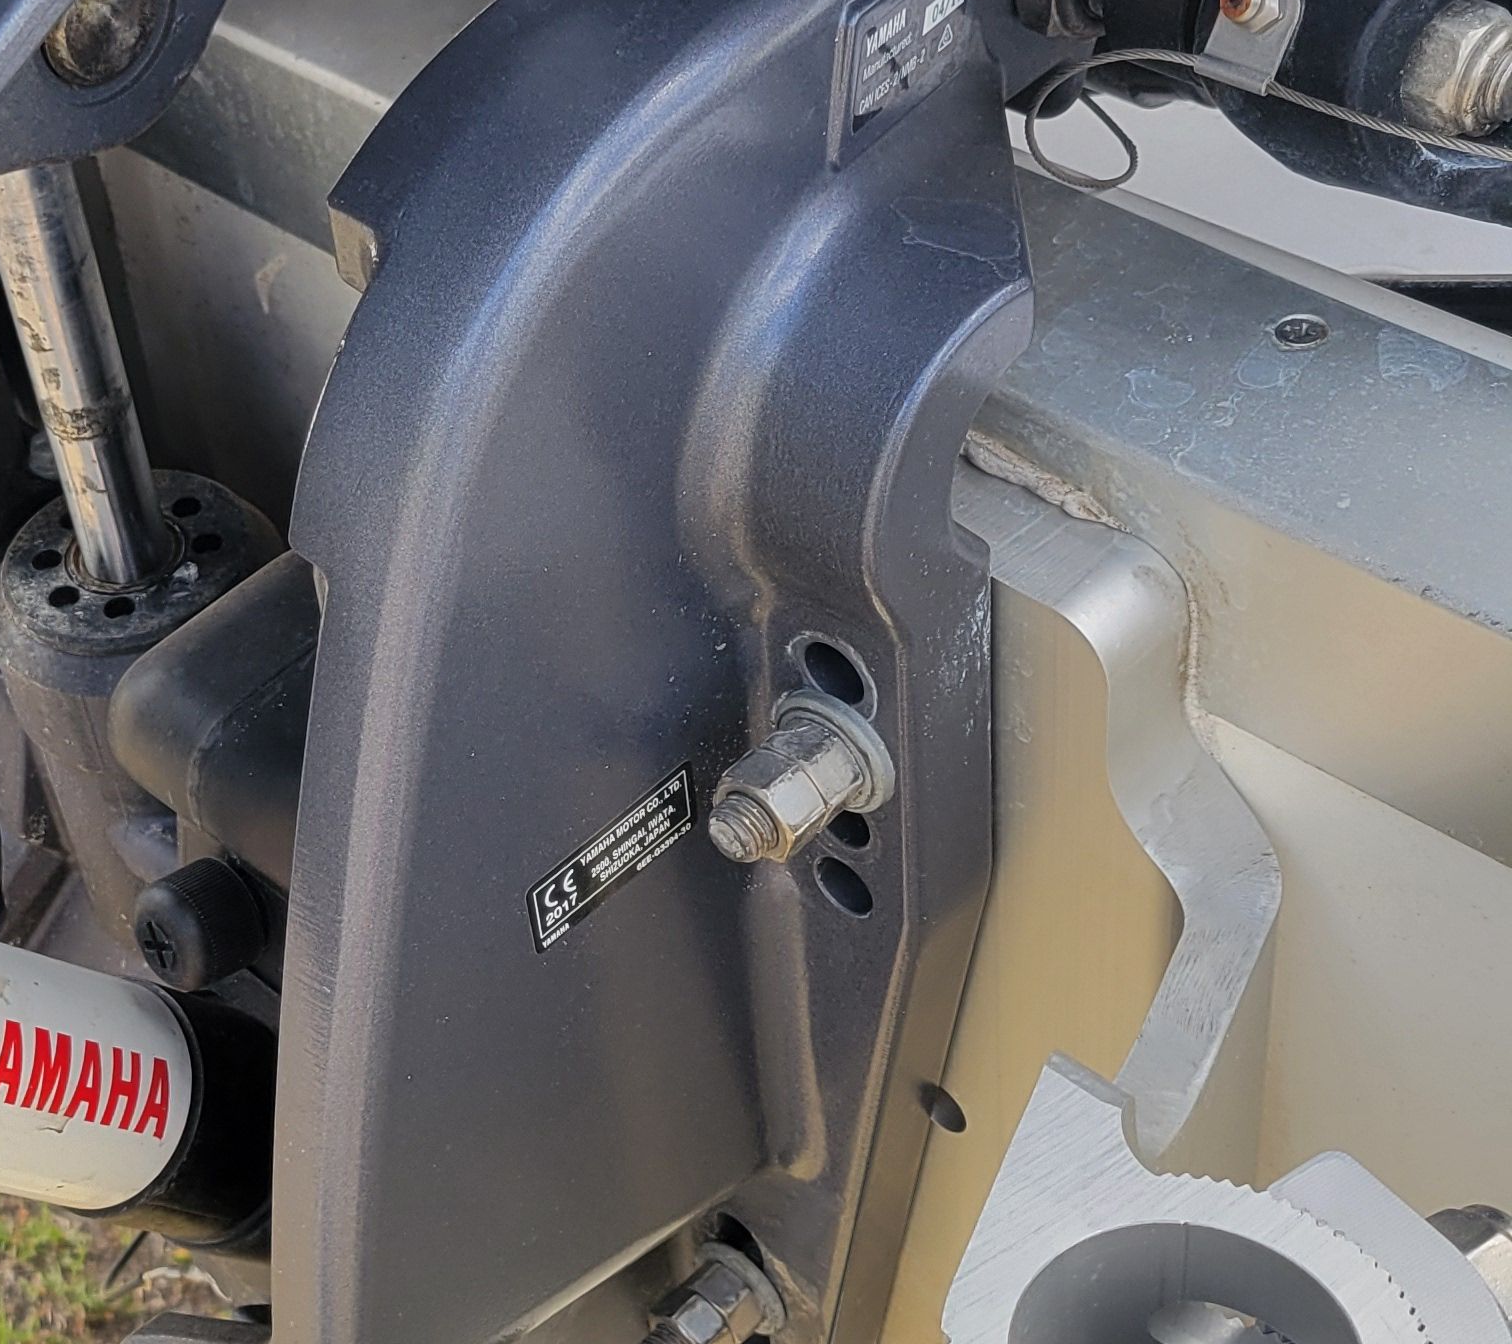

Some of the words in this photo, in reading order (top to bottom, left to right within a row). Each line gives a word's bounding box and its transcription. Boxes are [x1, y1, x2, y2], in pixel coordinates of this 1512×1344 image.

[866, 7, 907, 57] YAMAHA
[859, 91, 874, 115] CAN
[580, 833, 616, 867] YAMAHA
[615, 807, 646, 839] MOTOR
[646, 797, 664, 813] CO.,
[663, 780, 682, 800] LTD.
[591, 856, 612, 878] 2500,
[612, 826, 648, 860] SHINGAI,
[647, 804, 676, 832] IWATA,
[599, 843, 644, 882] SHIZUOKA,
[644, 818, 671, 847] JAPAN
[545, 892, 578, 927] 2017
[541, 922, 570, 949] YAMAHA
